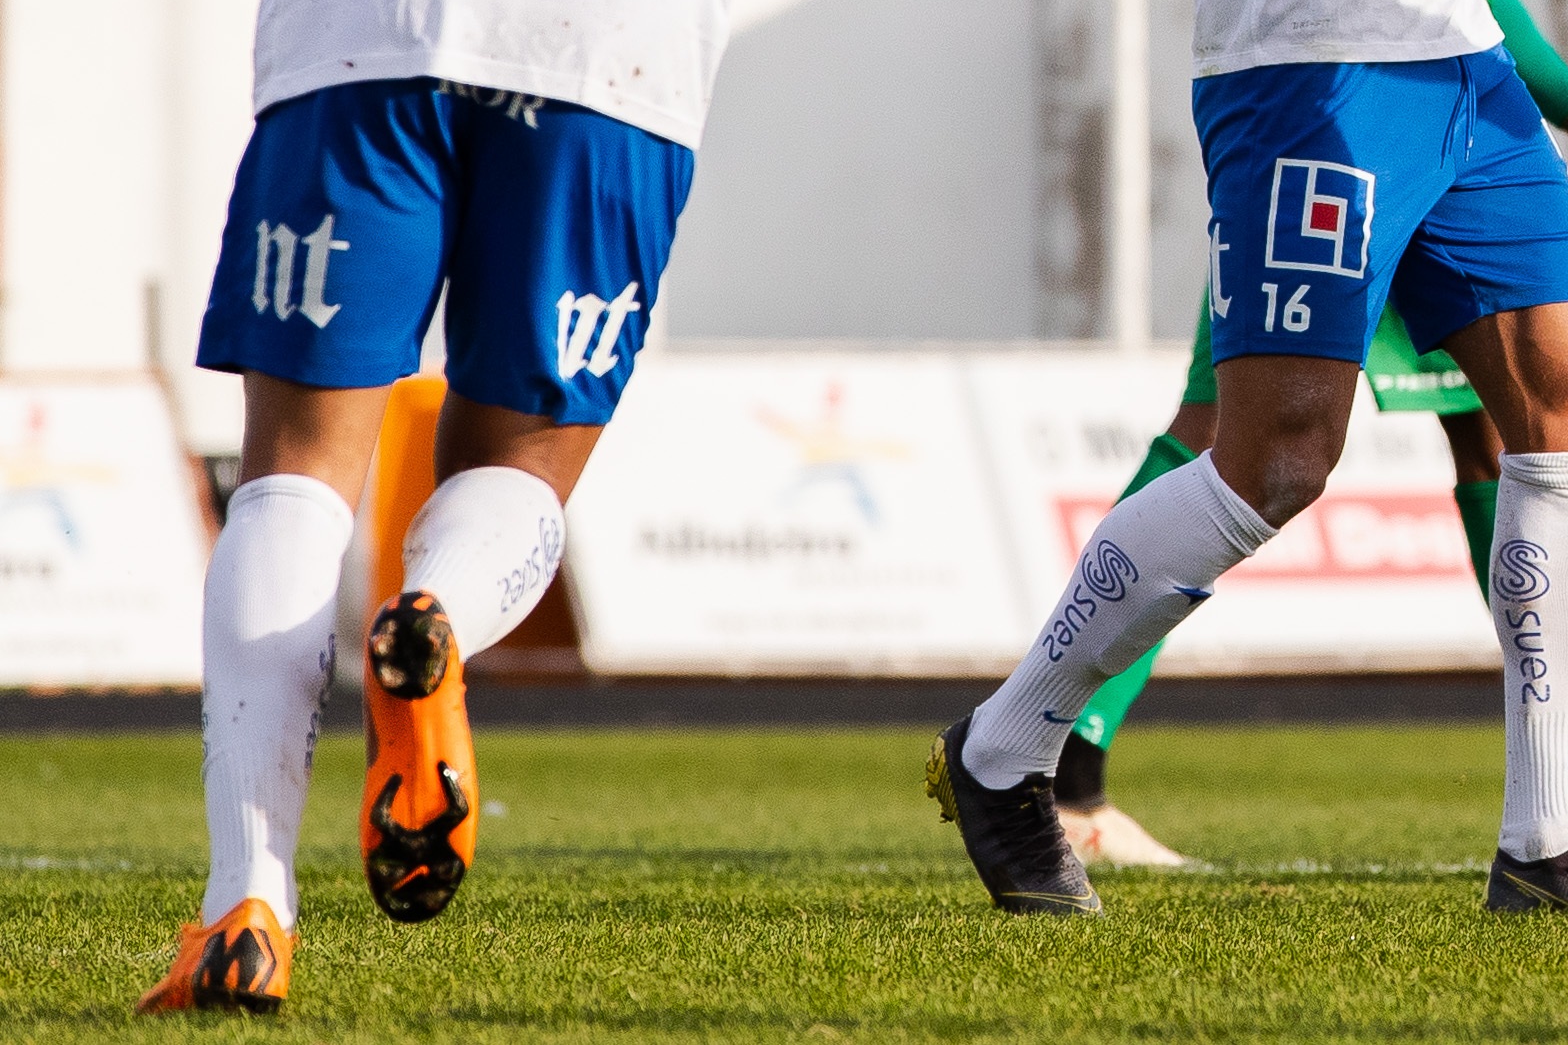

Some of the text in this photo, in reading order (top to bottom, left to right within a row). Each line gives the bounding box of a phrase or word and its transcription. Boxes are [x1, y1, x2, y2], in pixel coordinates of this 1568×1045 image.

[1261, 282, 1311, 332] 16
[1043, 583, 1097, 662] suez
[1504, 608, 1551, 705] suez
